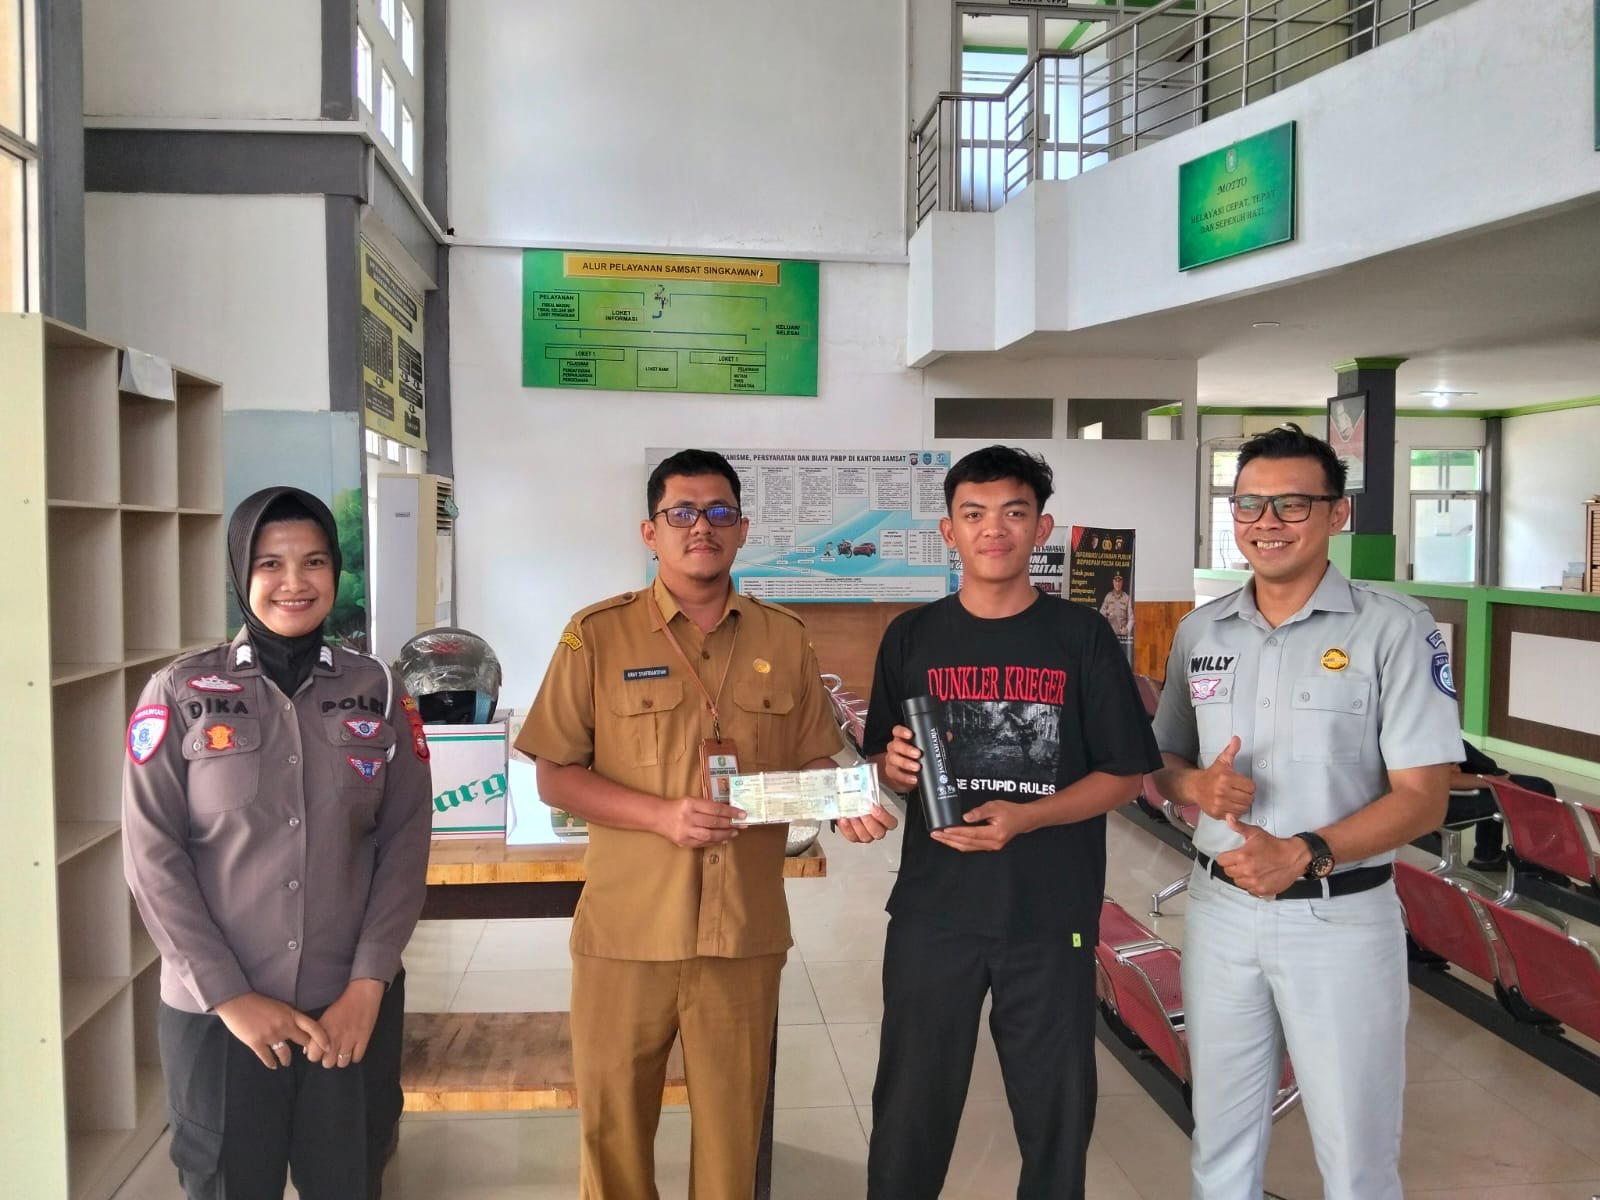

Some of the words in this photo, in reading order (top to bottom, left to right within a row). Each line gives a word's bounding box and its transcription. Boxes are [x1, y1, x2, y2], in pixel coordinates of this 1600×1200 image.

[1216, 177, 1248, 195] MOTTO
[1190, 206, 1225, 224] MELAYANI
[1200, 223, 1214, 234] DAN
[1215, 213, 1246, 230] SEPENUH
[582, 262, 607, 271] ALUR
[609, 263, 663, 273] PELAYANAN
[665, 264, 701, 274] SAMSAT
[703, 266, 764, 277] SINGKAWANG
[753, 454, 796, 462] PERSYARATAN
[797, 454, 810, 462] DAN
[811, 454, 829, 462] BIAYA
[1190, 655, 1234, 673] WILLY
[1003, 666, 1067, 705] KRIEGER
[189, 698, 249, 719] DIKA
[321, 695, 384, 716] POLRI
[970, 779, 1017, 792] STUPID
[1019, 782, 1056, 795] RULES
